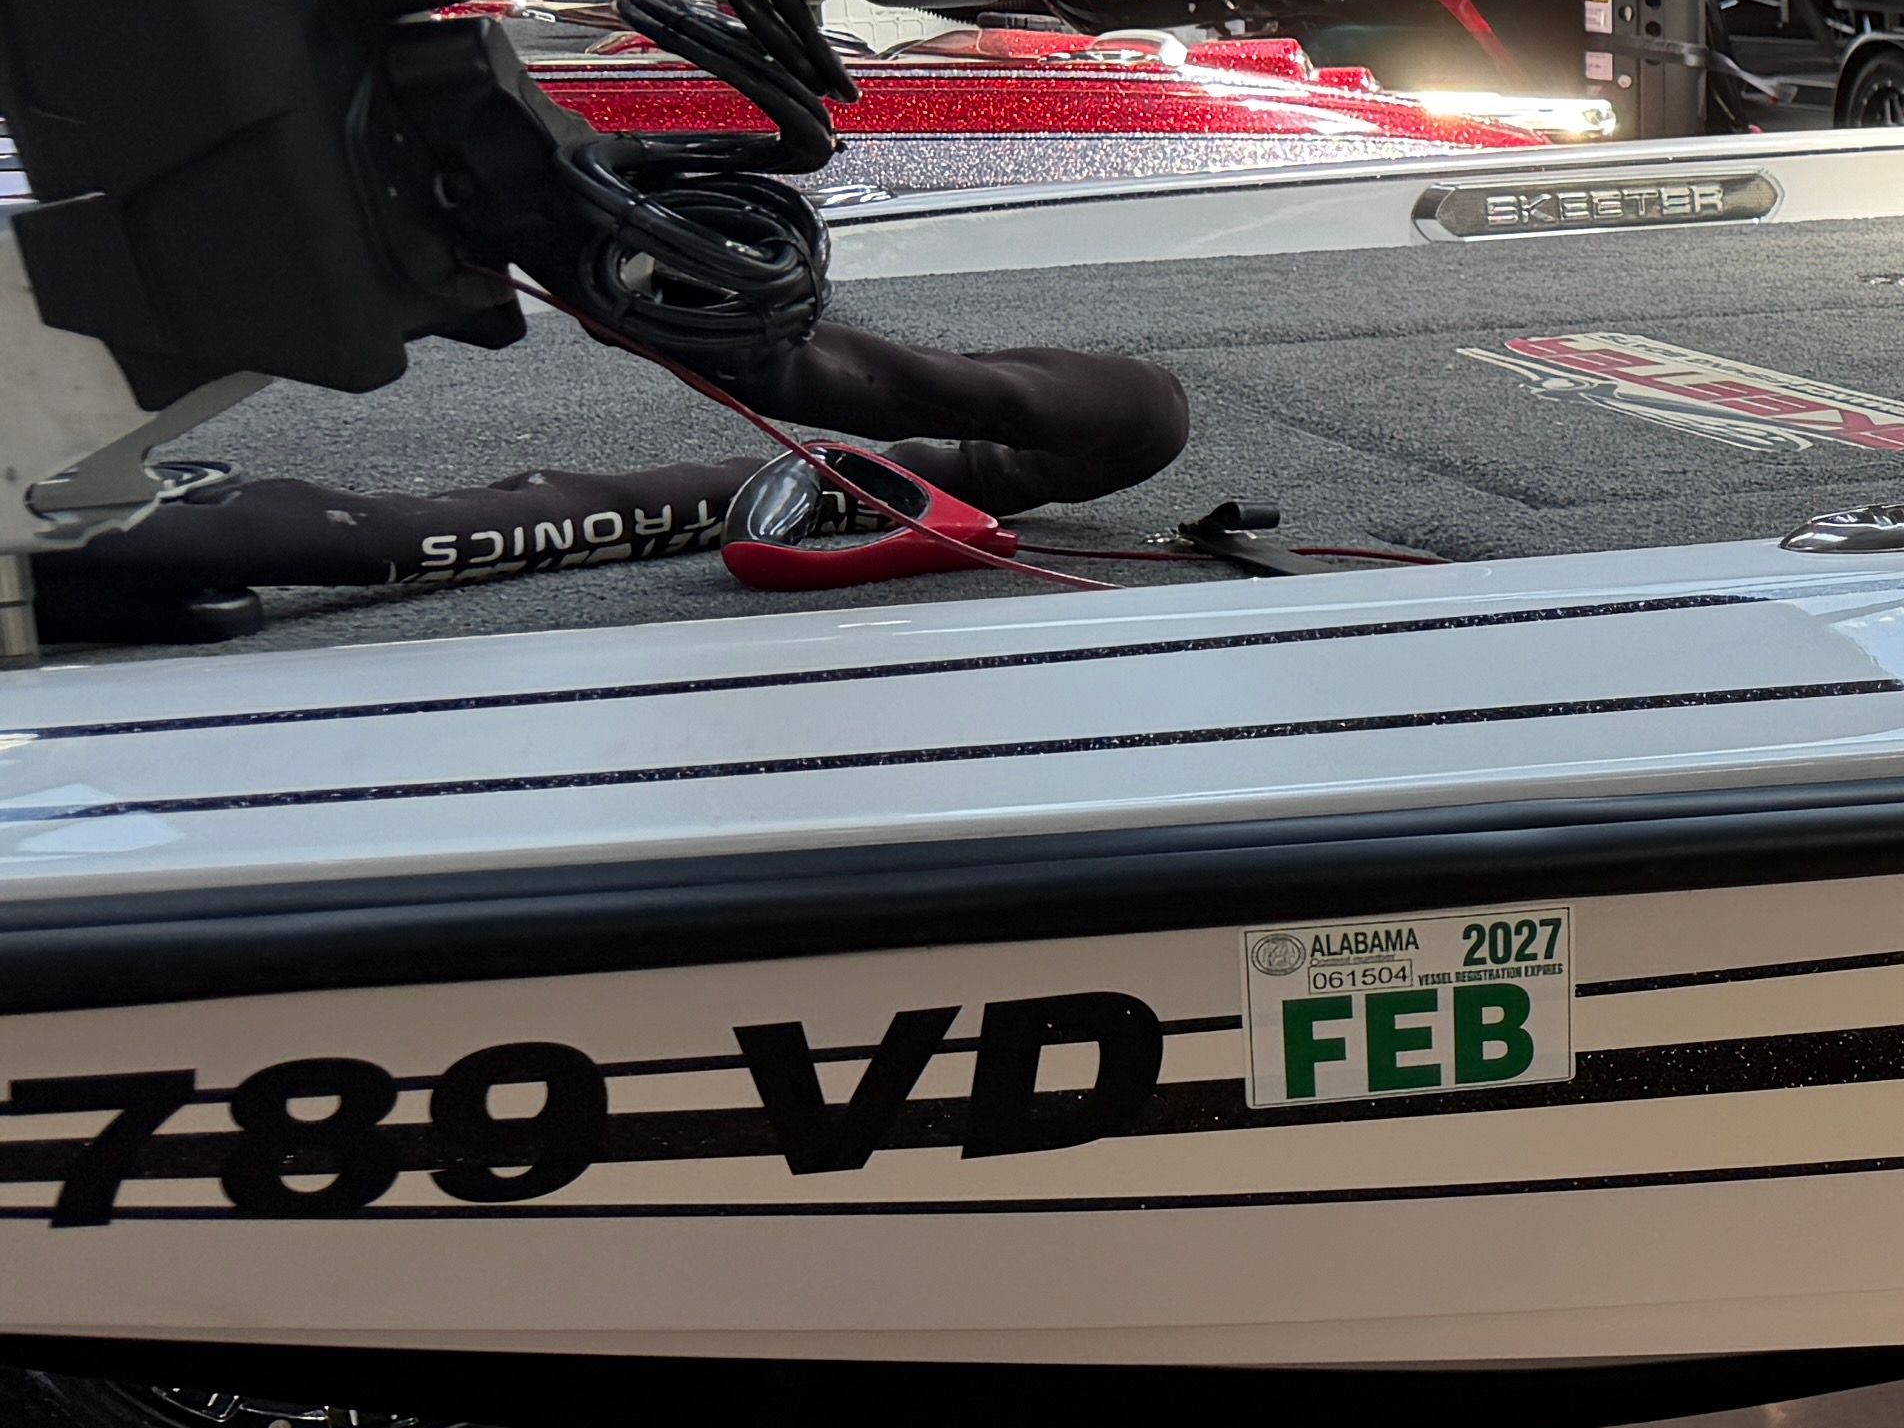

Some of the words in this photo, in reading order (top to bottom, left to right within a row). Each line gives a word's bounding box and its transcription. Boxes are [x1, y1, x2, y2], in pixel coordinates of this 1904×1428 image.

[1484, 184, 1726, 228] SKEETER
[1310, 927, 1420, 958] ALABAMA
[1462, 917, 1563, 967] 2027
[1312, 965, 1408, 991] 061504
[1282, 982, 1535, 1100] FEB
[733, 991, 1164, 1176] VD
